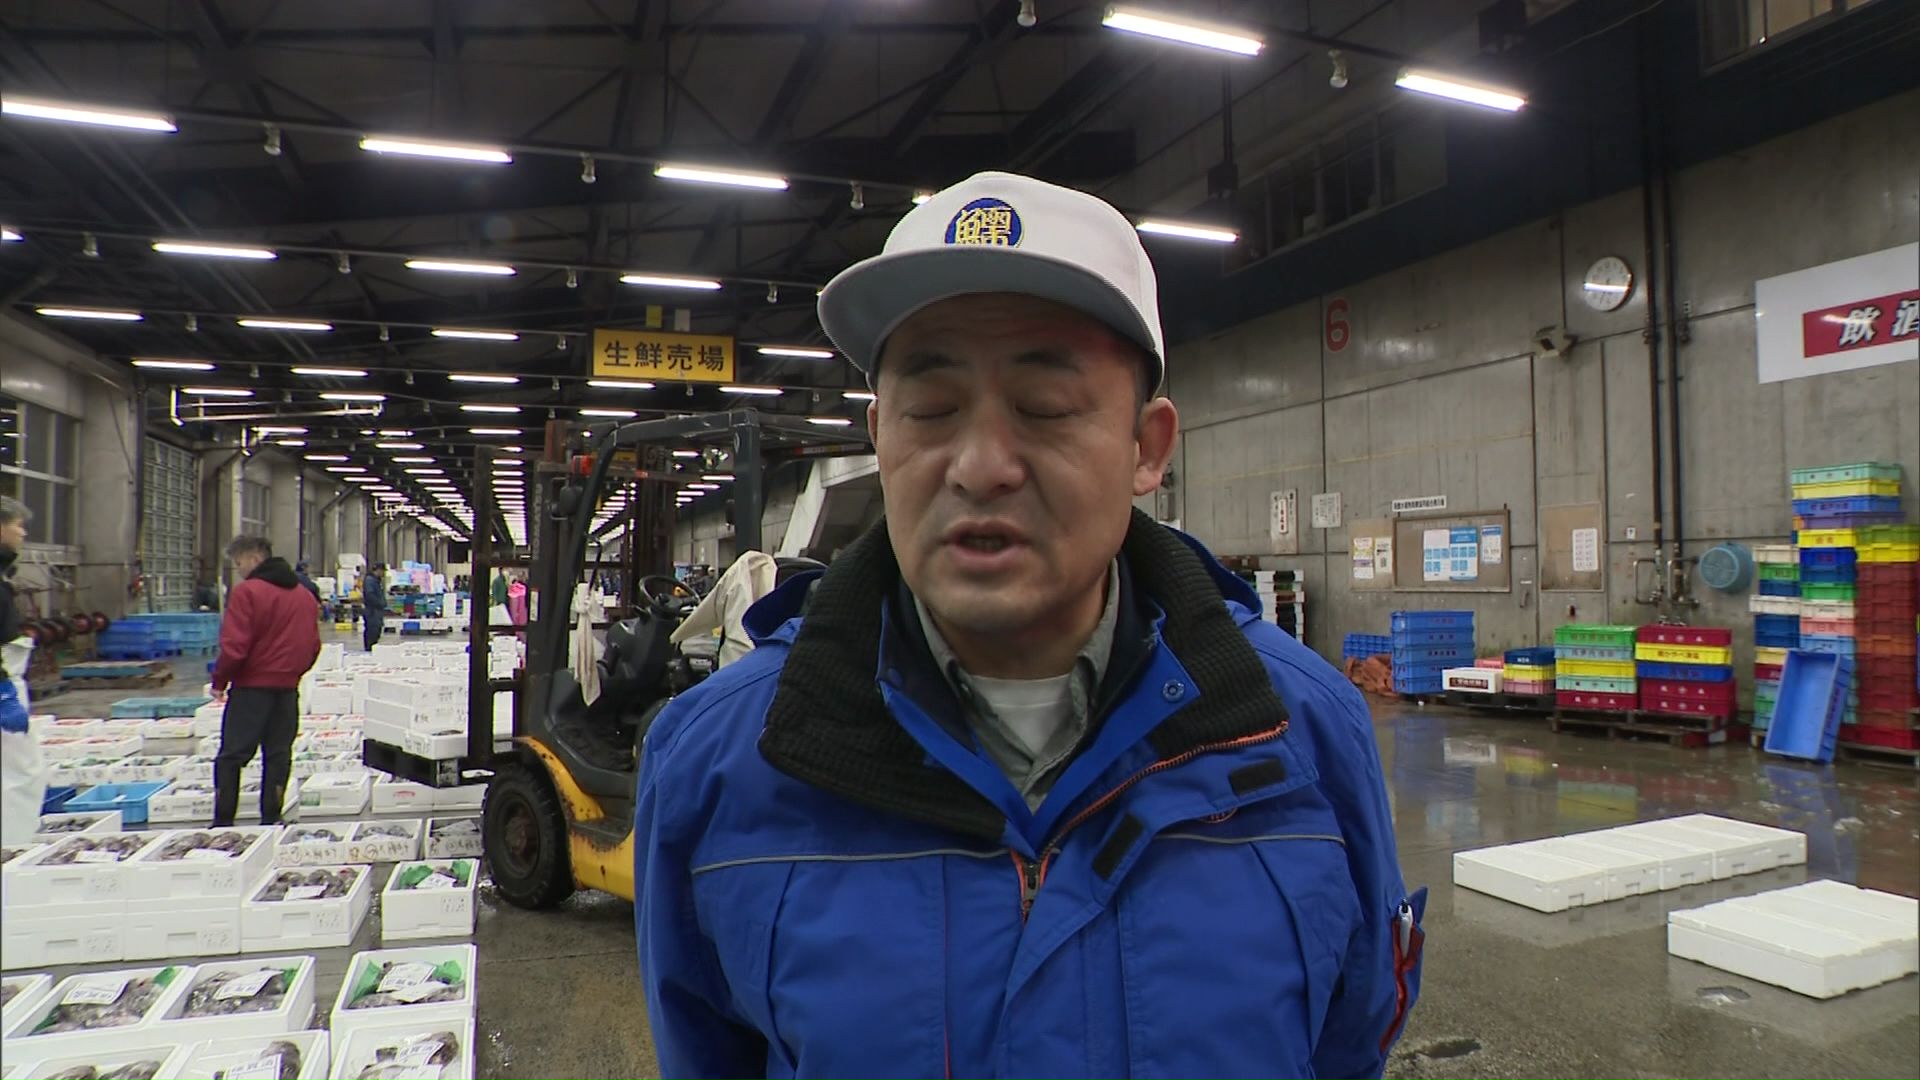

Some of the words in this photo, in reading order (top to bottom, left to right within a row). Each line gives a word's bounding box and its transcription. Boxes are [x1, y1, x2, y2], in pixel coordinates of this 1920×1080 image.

[1327, 298, 1349, 352] 6
[603, 340, 724, 372] 生鮮売場
